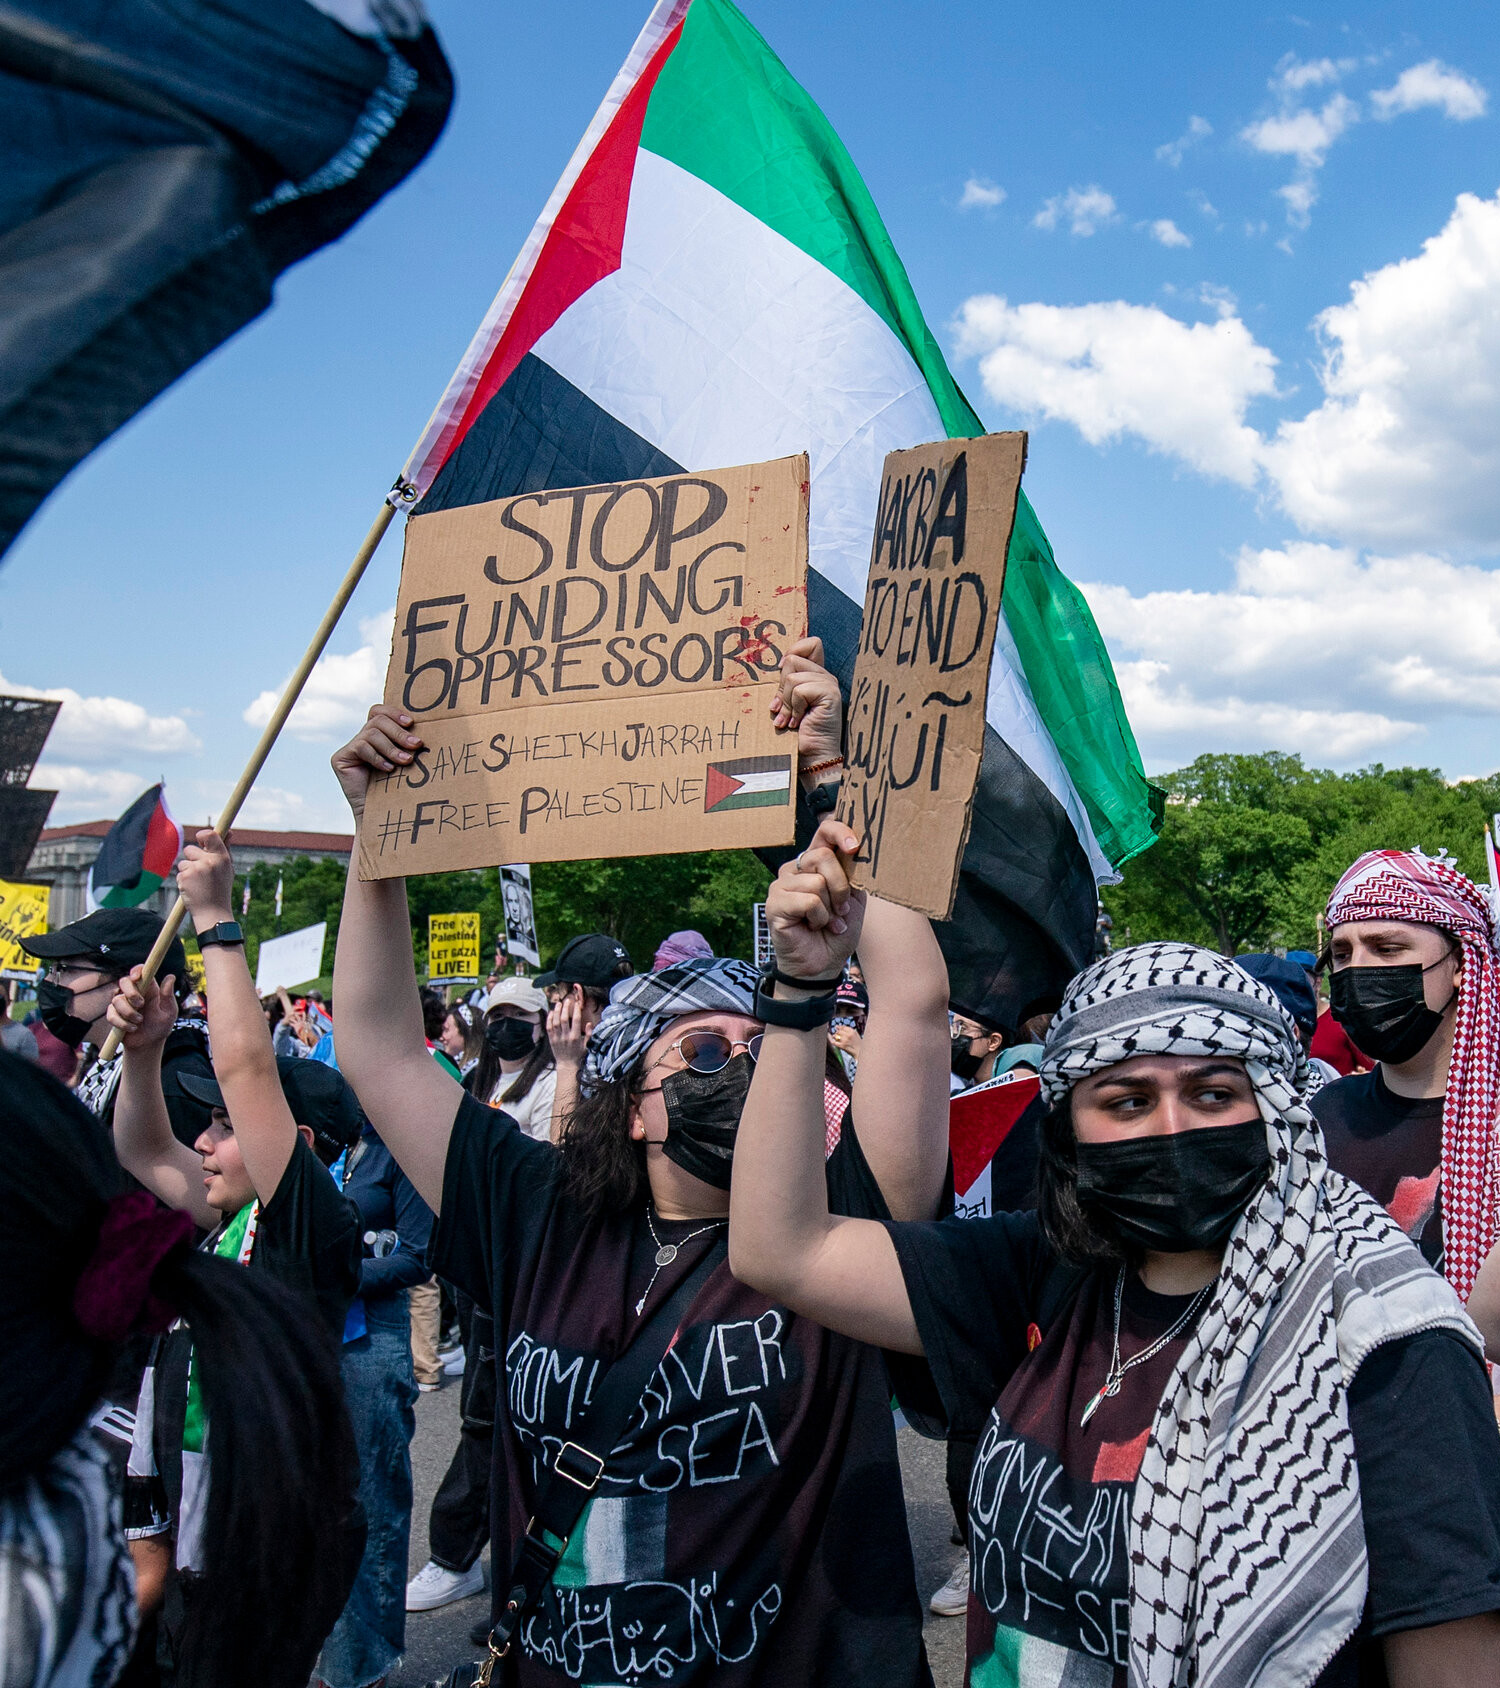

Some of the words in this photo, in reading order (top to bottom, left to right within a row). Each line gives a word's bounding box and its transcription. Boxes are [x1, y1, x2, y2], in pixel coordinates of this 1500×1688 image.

[484, 478, 728, 584] STOP
[874, 451, 967, 571] NAKBA
[402, 542, 745, 673] FUNDING
[864, 577, 898, 658] TO
[896, 571, 988, 673] END
[402, 620, 787, 712] OPPRESSORS
[378, 800, 510, 855] #FREE
[520, 778, 703, 833] PALESTINE
[431, 920, 456, 930] Free
[431, 931, 477, 943] Palestine
[431, 949, 448, 960] LET
[451, 947, 477, 958] GAZA
[437, 960, 471, 976] LIVE!
[638, 1402, 779, 1492] SEA
[1075, 1590, 1130, 1666] SE
